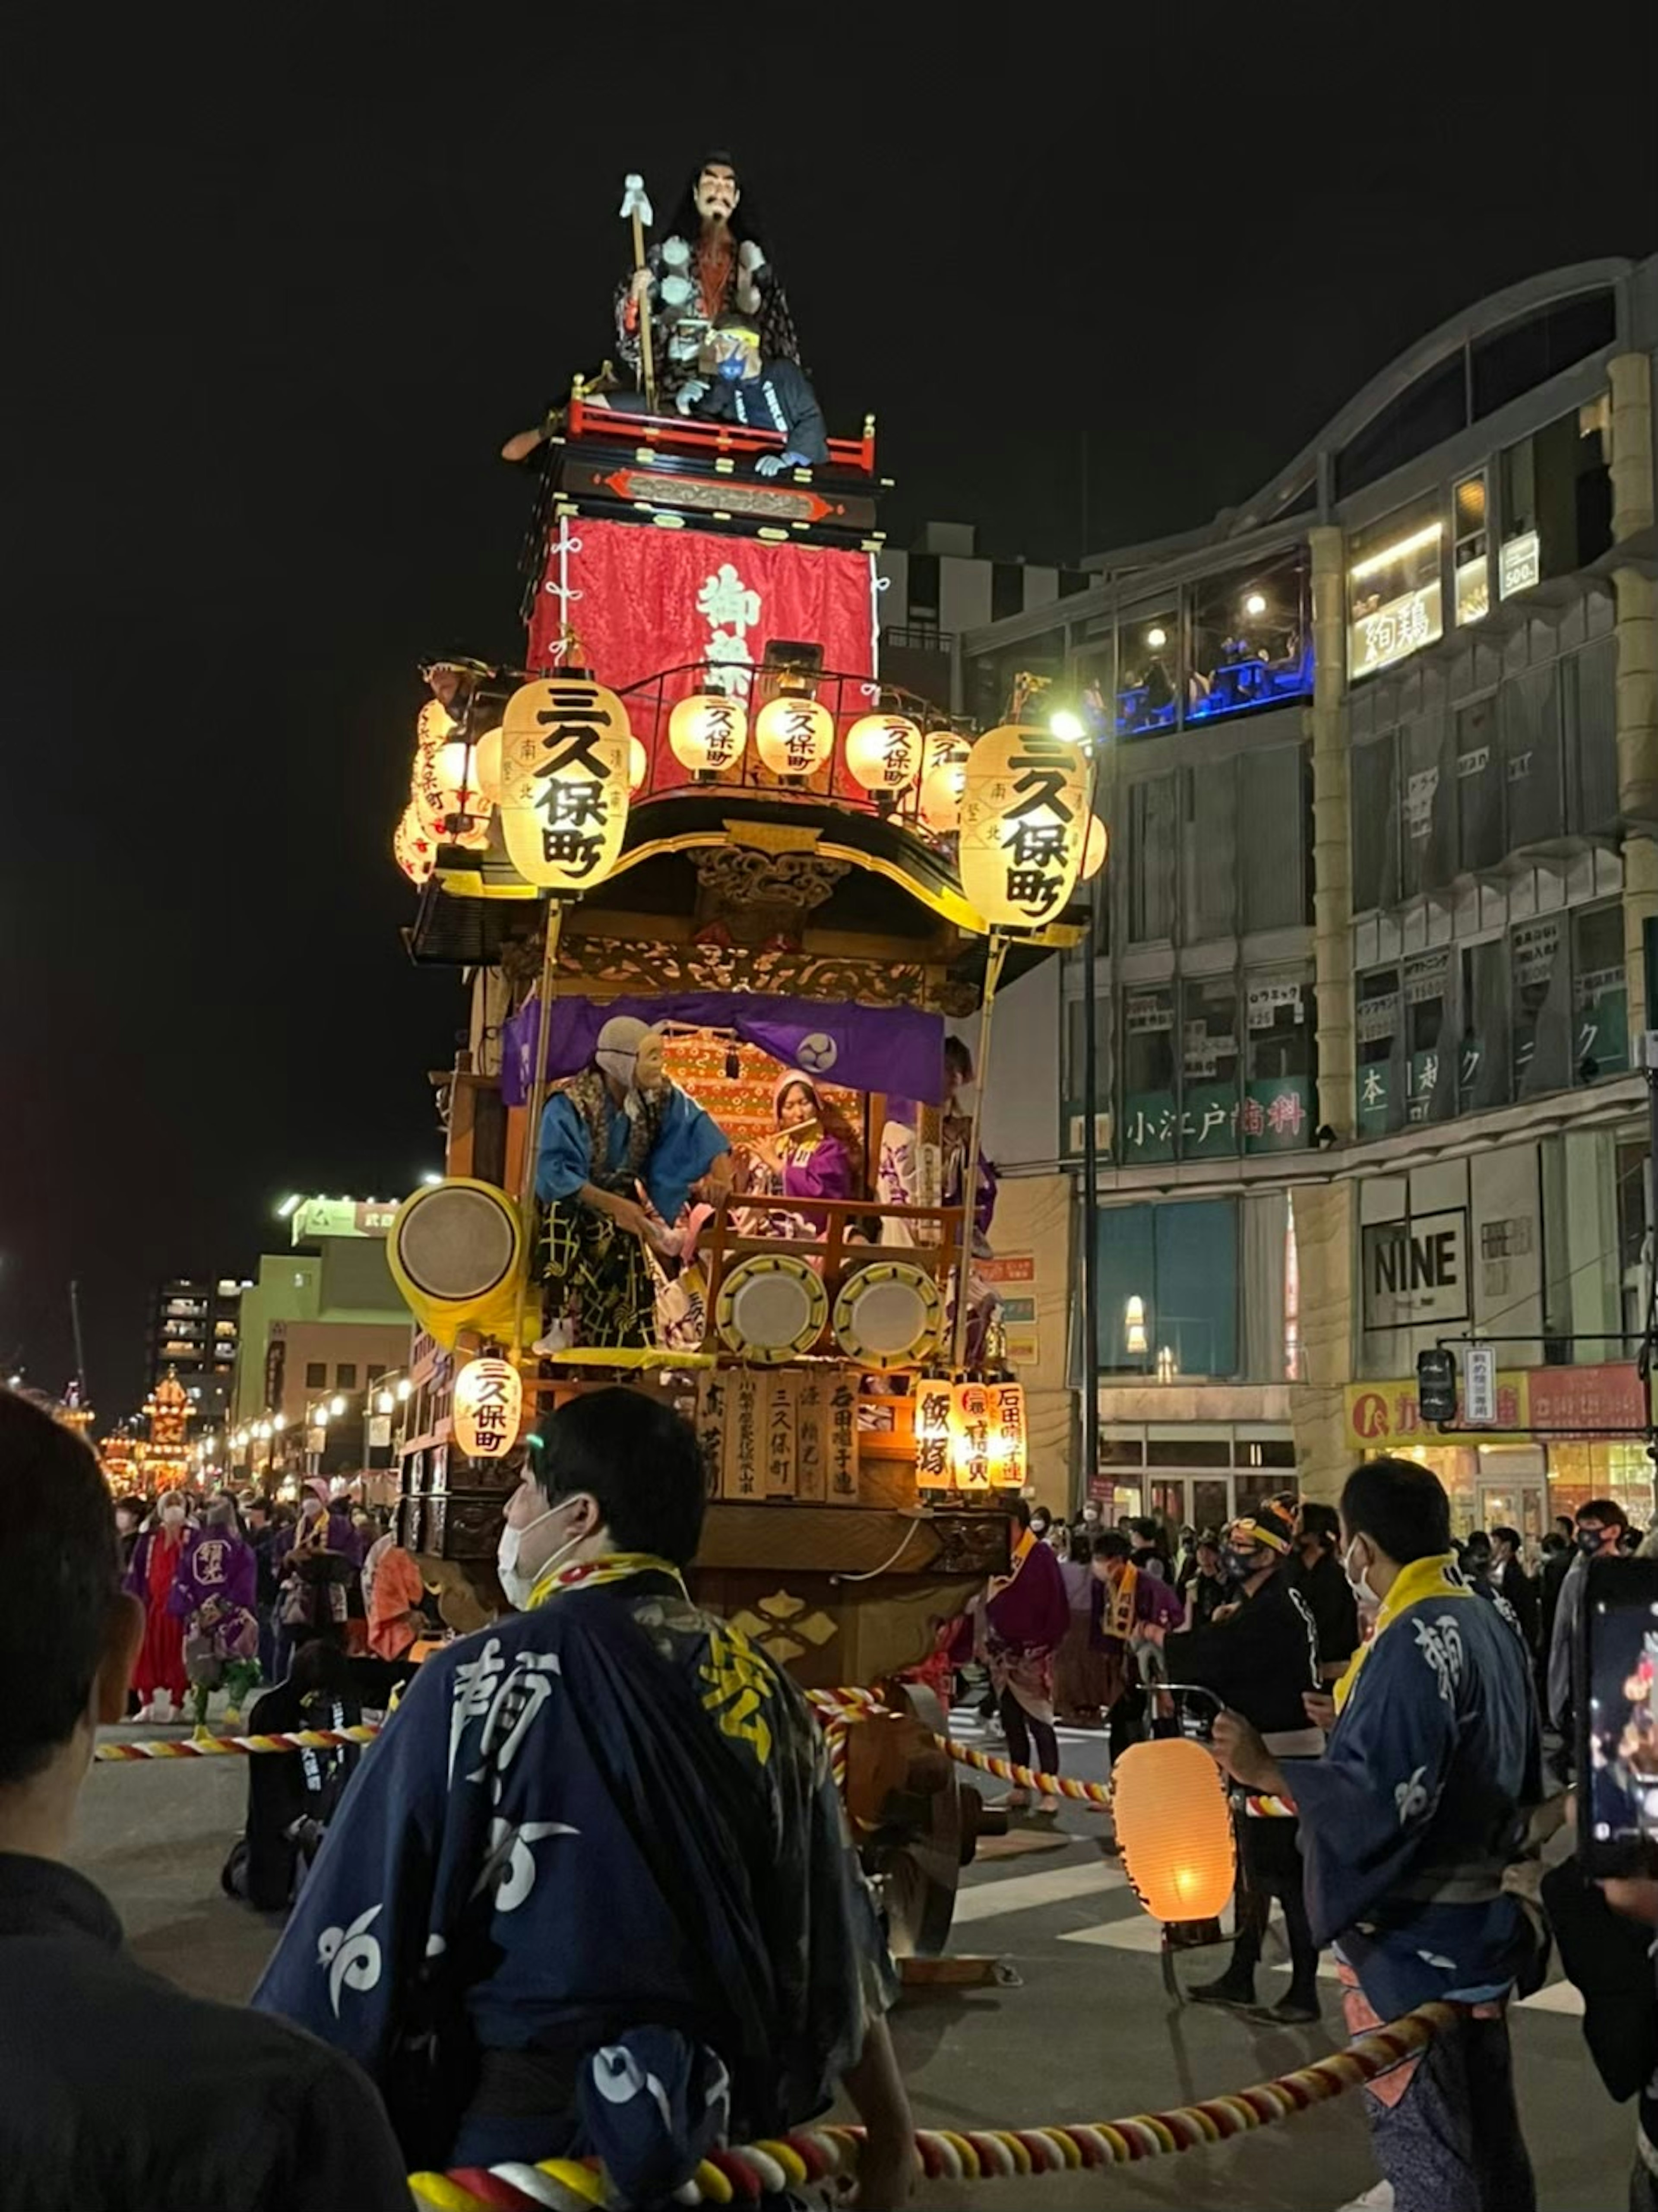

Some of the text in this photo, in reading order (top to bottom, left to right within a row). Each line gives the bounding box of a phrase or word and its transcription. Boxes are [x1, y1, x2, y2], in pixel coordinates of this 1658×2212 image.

[695, 563, 762, 707] 御祭
[520, 738, 536, 760] 南
[705, 698, 735, 766] 三久保町
[785, 702, 818, 770] 三久保町
[882, 719, 913, 786] 三久保町
[519, 785, 535, 801] 北
[533, 687, 612, 879] 三久保町
[987, 826, 1001, 840] 北
[1002, 733, 1077, 917] 三久保町
[1375, 1231, 1456, 1294] NINE
[472, 1361, 510, 1452] 三久保町
[771, 1390, 791, 1484] 三久保町
[916, 1391, 950, 1475] 飯塚
